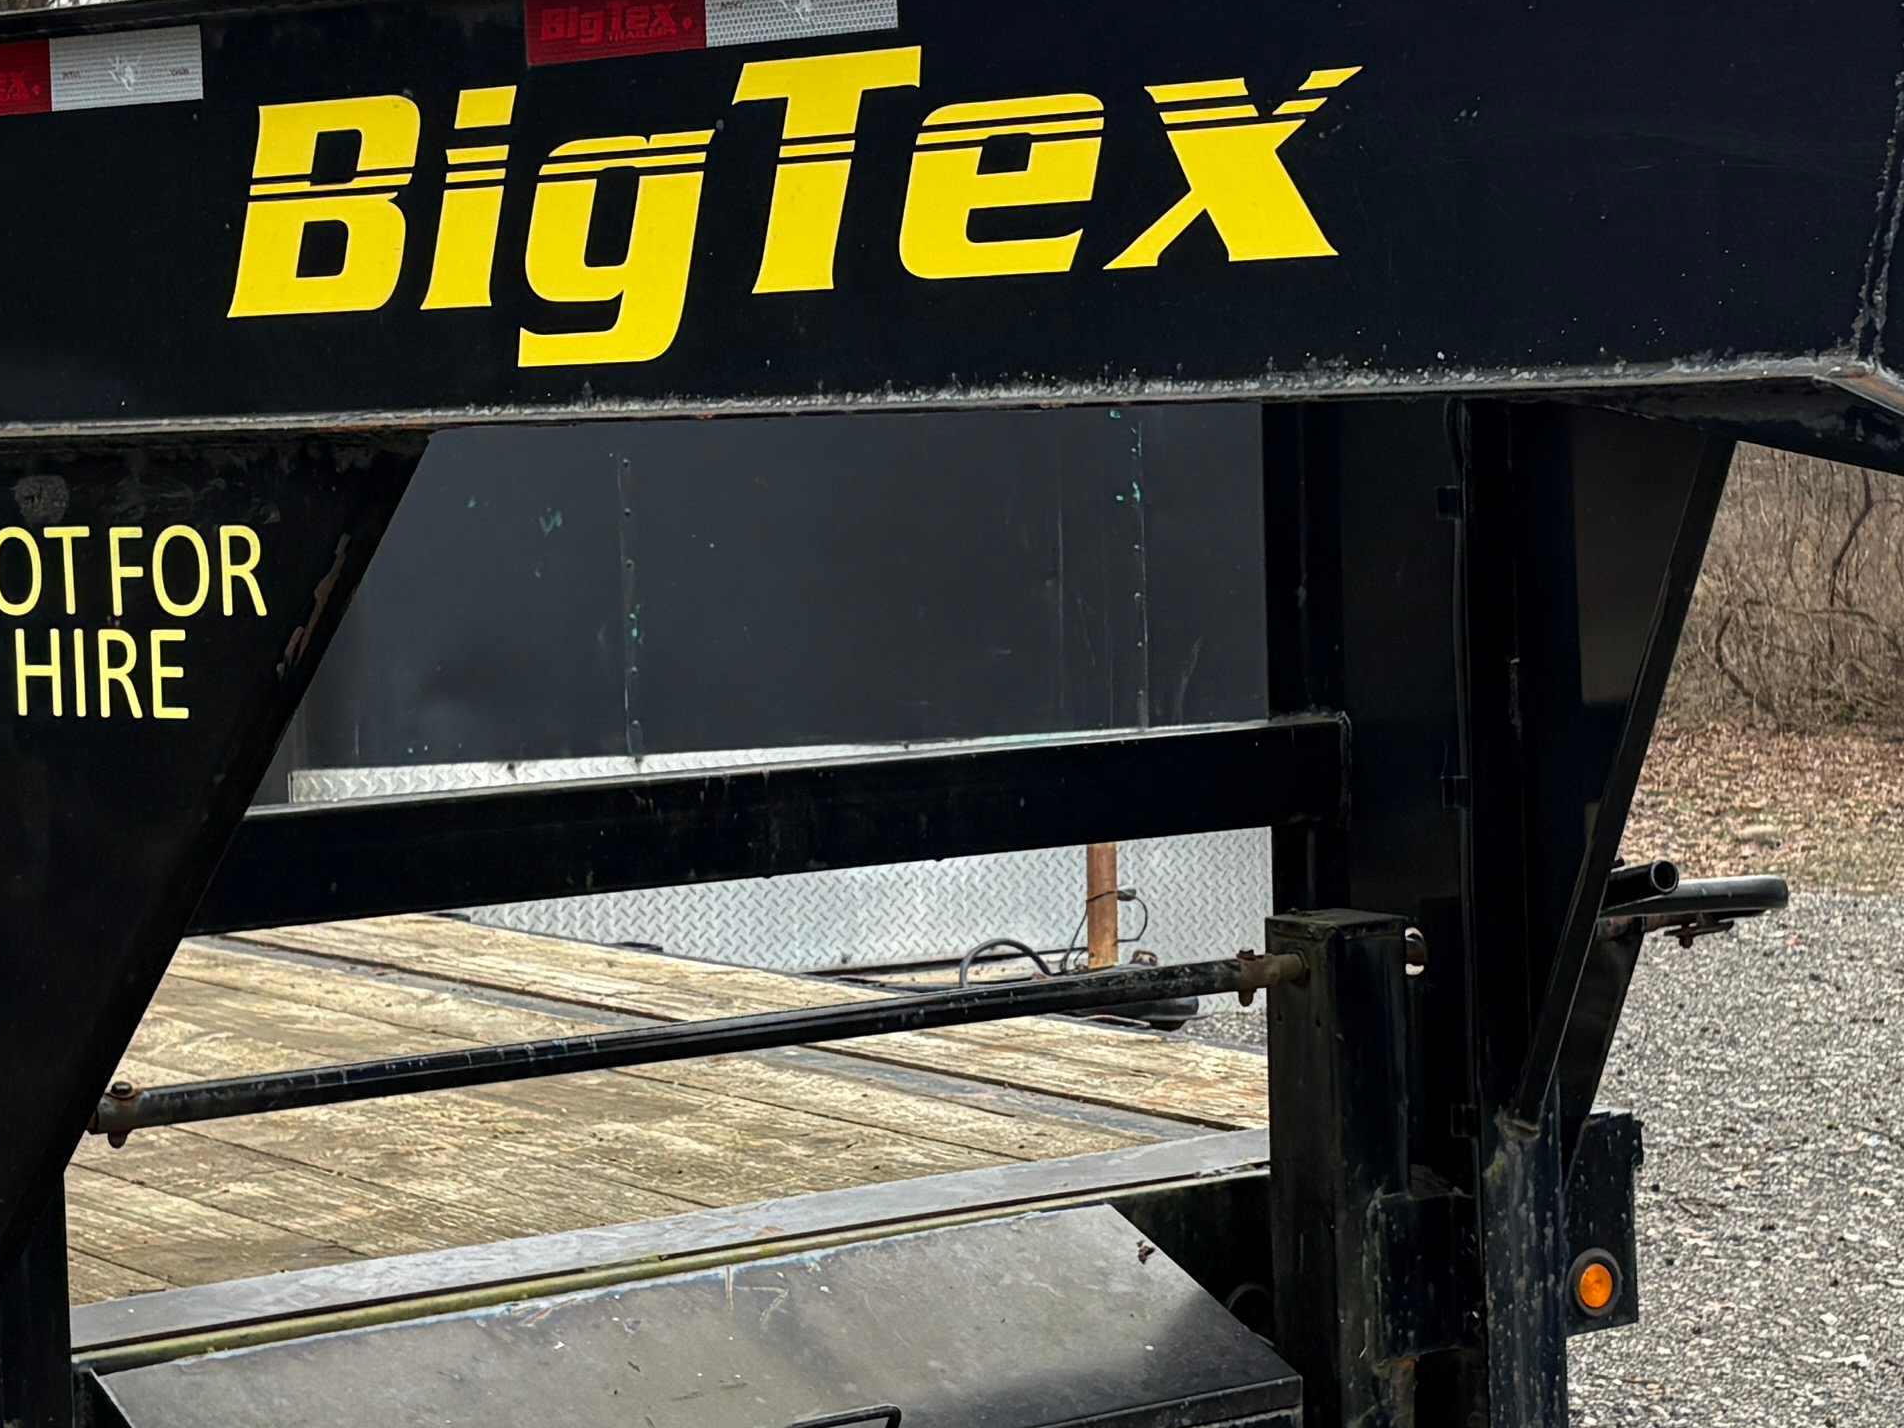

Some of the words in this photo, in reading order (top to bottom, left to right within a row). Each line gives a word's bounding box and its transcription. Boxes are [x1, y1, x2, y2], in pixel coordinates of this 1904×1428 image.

[227, 45, 1363, 368] BigTex
[109, 524, 268, 617] FOR
[14, 628, 190, 719] HIRE
